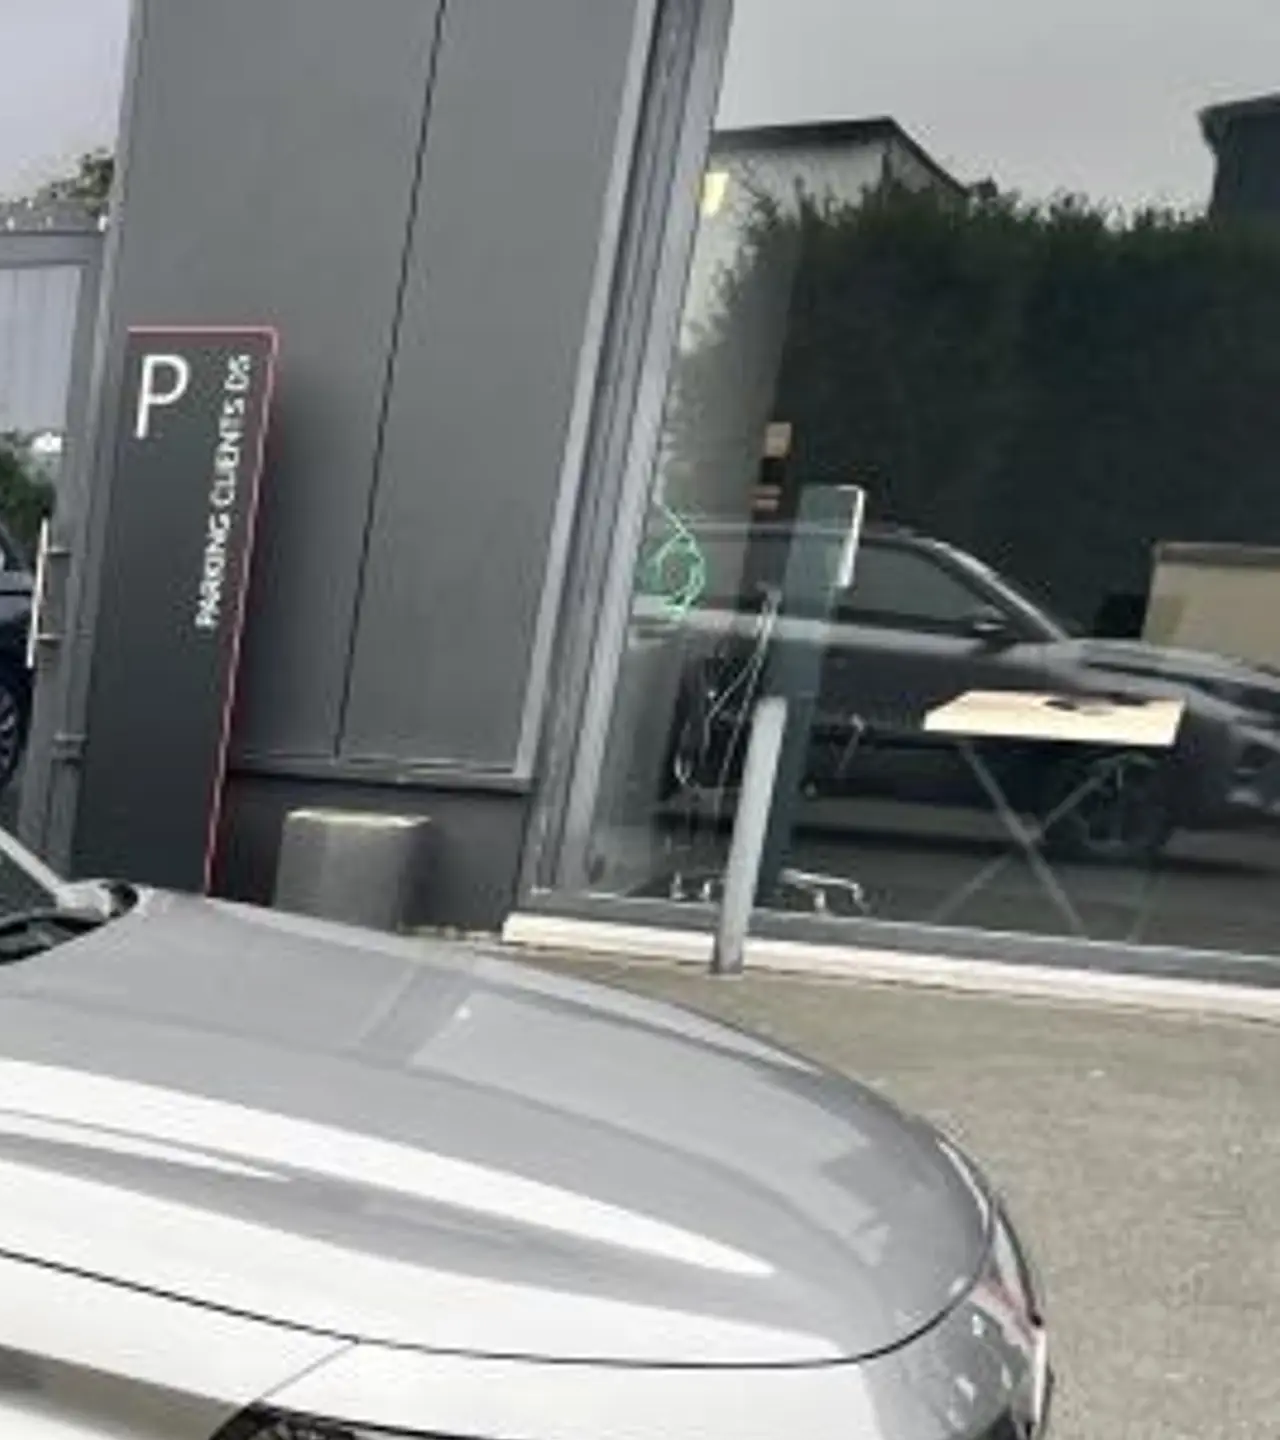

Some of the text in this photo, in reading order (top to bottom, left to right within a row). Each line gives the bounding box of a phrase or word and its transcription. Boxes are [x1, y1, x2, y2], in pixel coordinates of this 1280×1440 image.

[133, 353, 189, 440] P
[194, 354, 251, 629] PARKING CLIENTS DS
